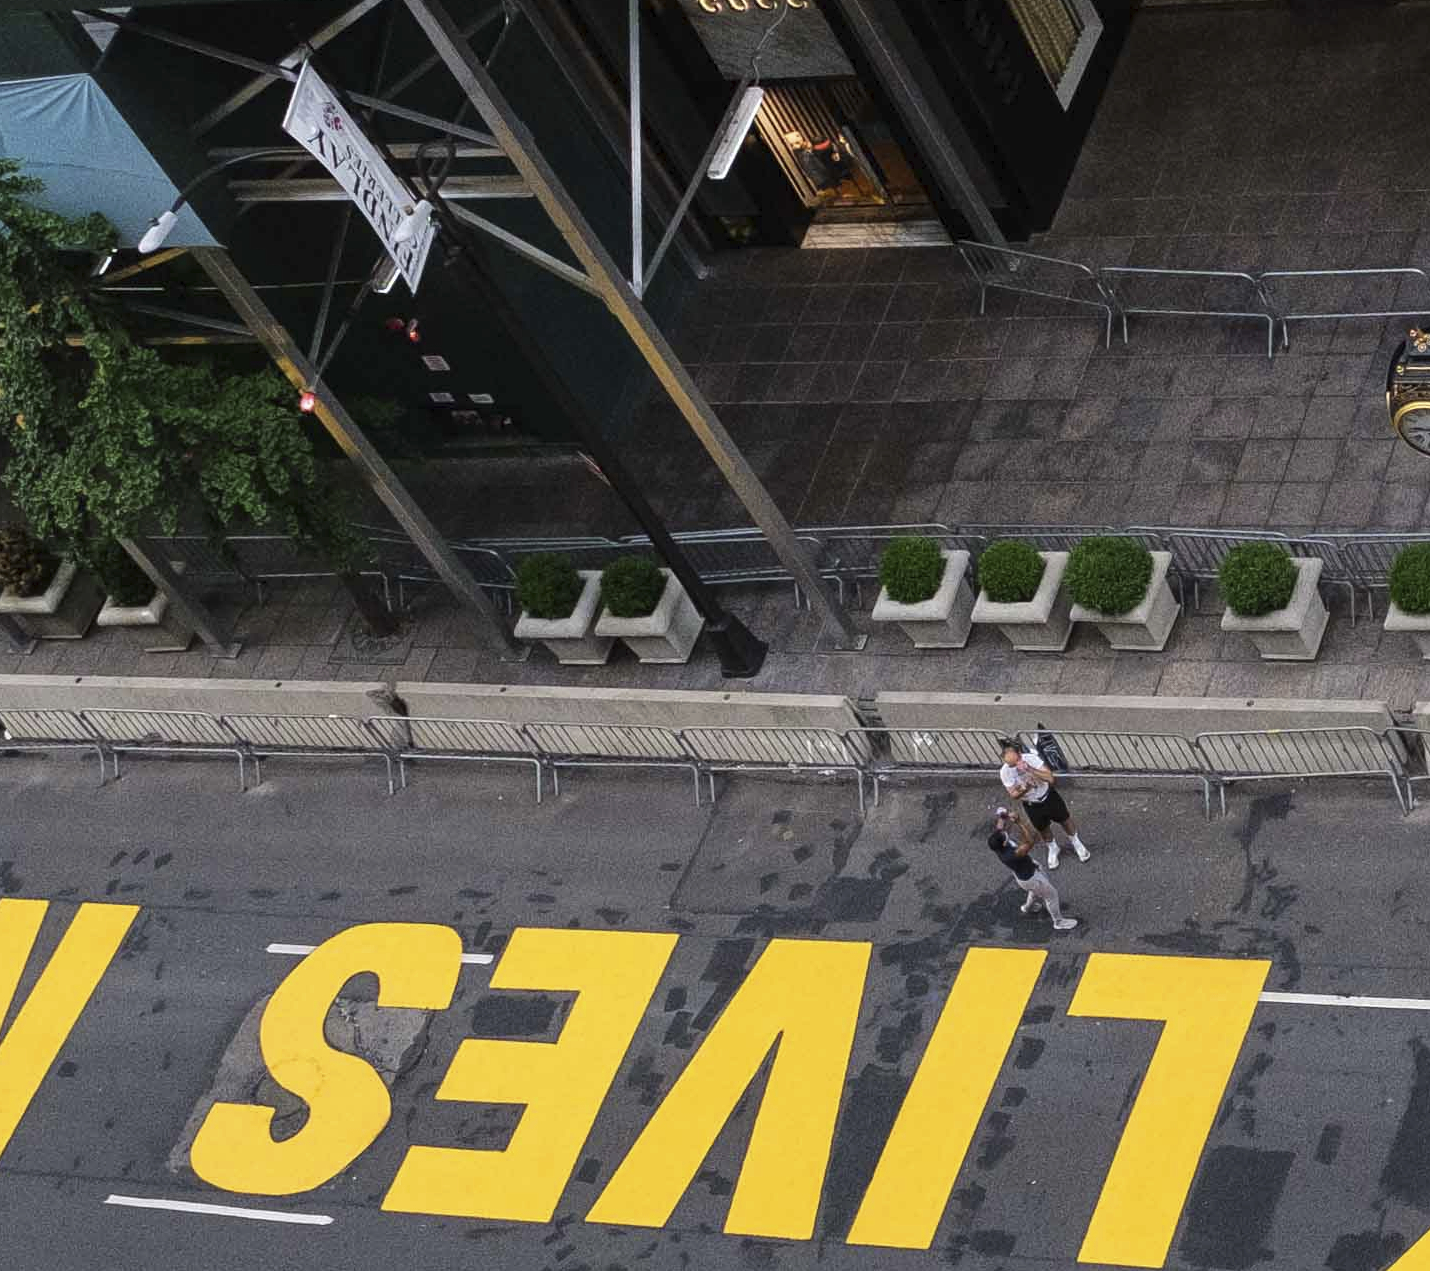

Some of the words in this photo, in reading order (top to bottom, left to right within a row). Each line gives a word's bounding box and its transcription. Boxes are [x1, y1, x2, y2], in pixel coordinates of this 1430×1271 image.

[306, 130, 414, 273] FINDLAY
[343, 143, 419, 250] GLLERIES
[190, 922, 1270, 1268] LIVES
